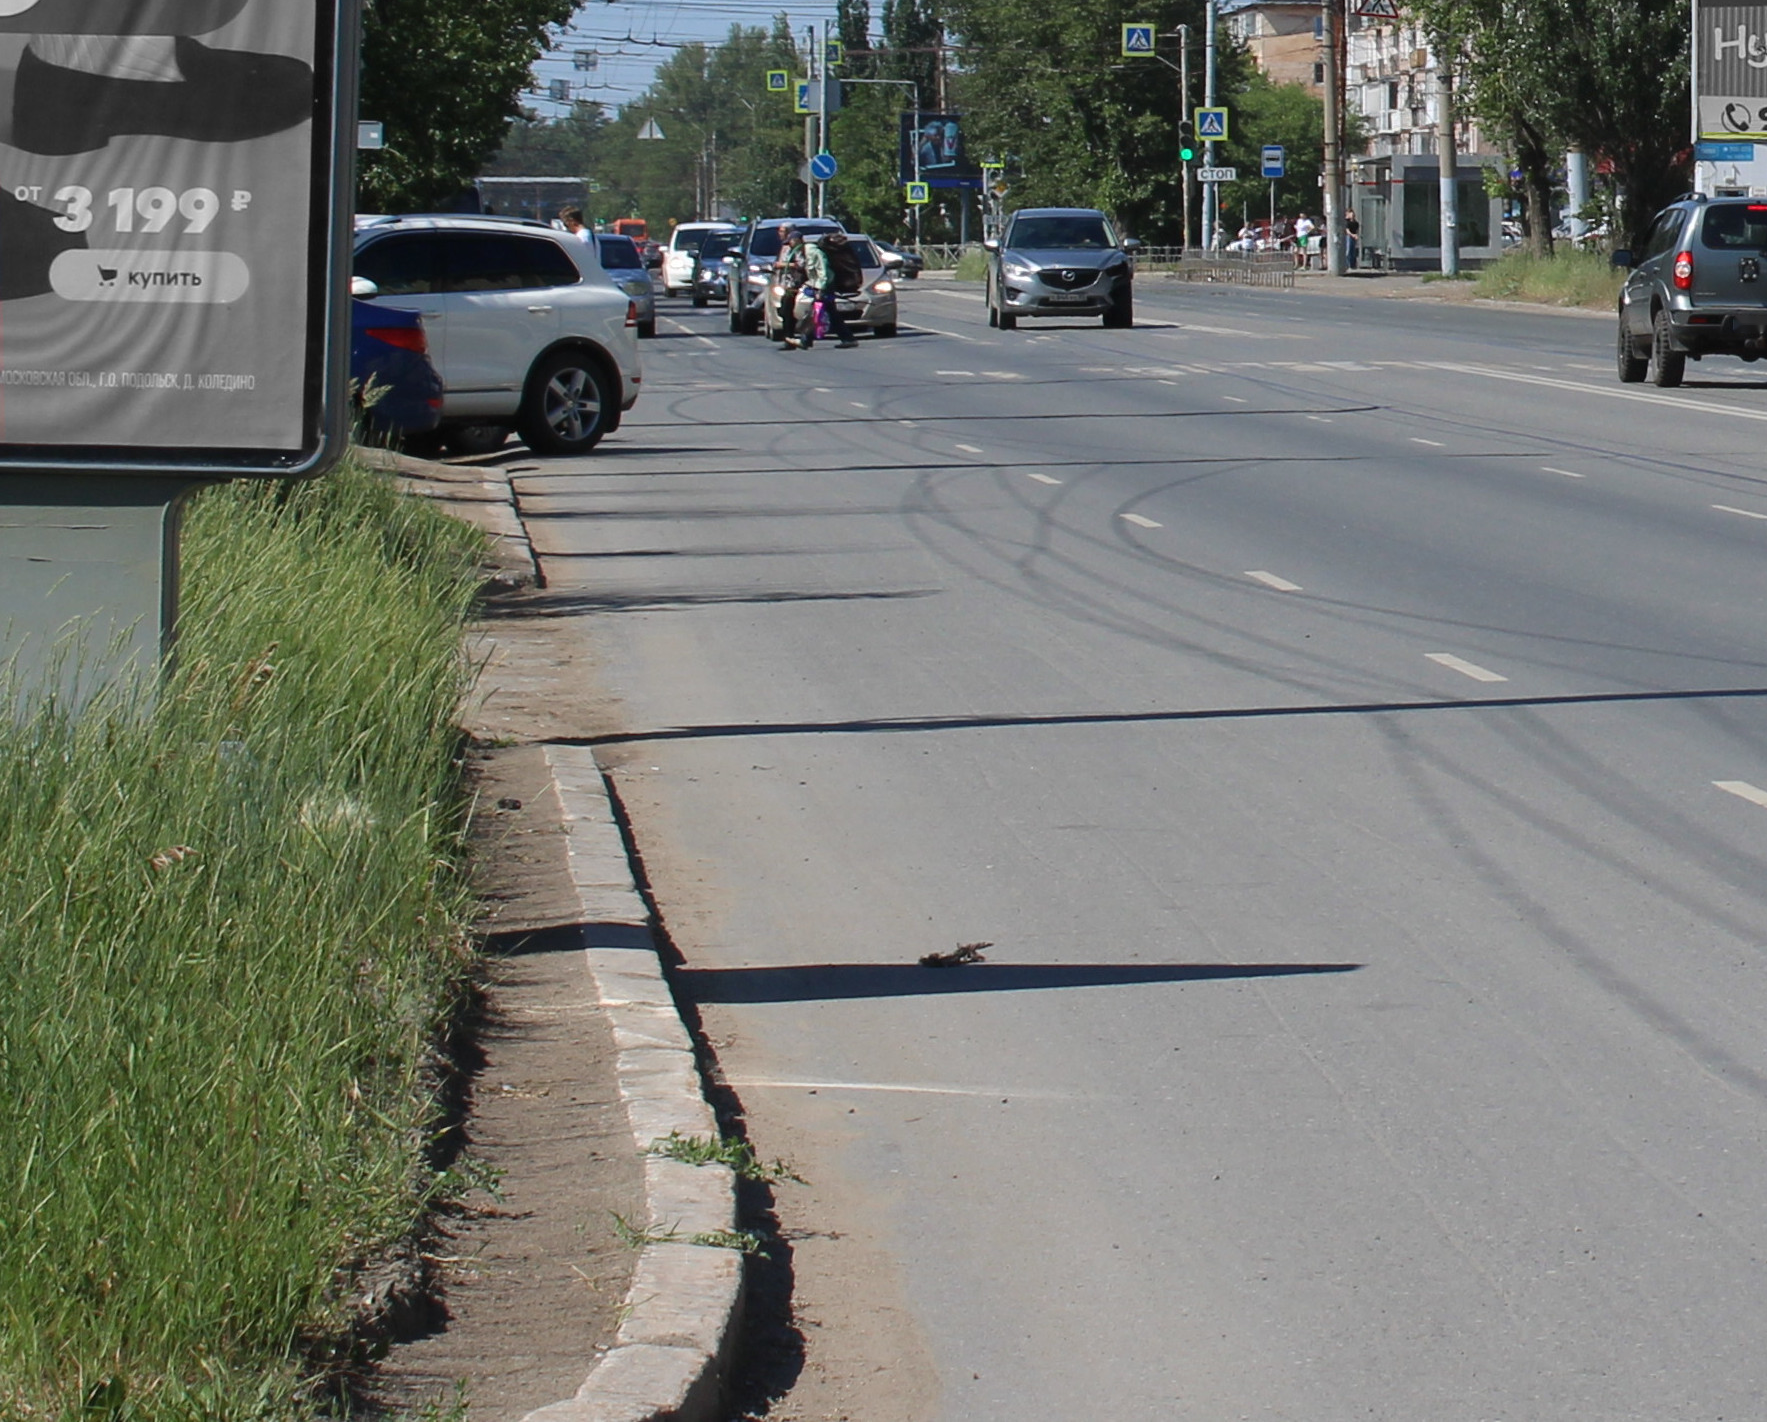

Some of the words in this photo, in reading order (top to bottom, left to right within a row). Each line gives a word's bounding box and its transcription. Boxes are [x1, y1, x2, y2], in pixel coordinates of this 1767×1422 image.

[1200, 168, 1234, 180] СТОП
[14, 186, 42, 202] от
[53, 185, 93, 233] 3
[108, 187, 220, 234] 199
[128, 272, 202, 289] купить
